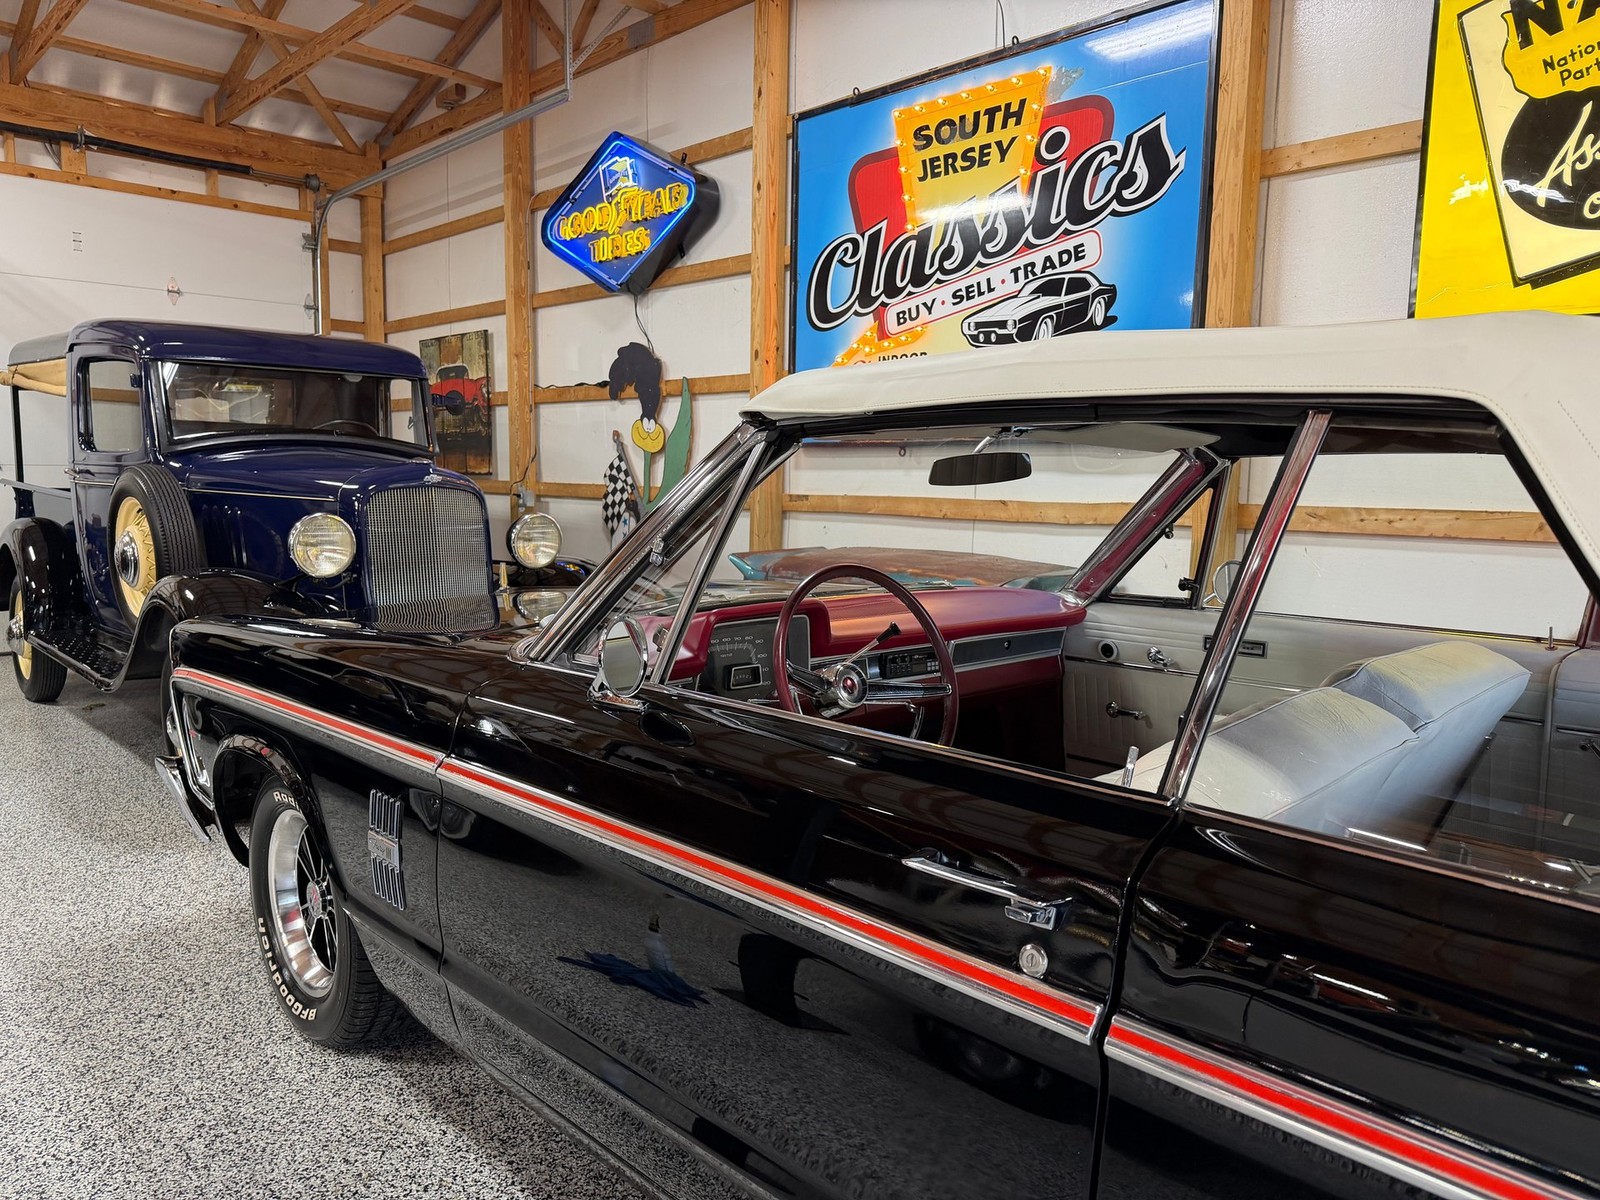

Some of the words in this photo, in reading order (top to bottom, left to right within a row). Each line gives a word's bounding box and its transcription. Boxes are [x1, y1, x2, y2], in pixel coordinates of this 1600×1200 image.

[1542, 41, 1600, 74] Natio
[913, 98, 1027, 152] SOUTH
[917, 135, 1019, 182] JERSEY
[554, 182, 689, 241] GOODYEAR
[807, 113, 1186, 332] Classics
[589, 227, 651, 262] TIRES
[896, 297, 937, 326] BUY
[951, 277, 996, 306] SELL
[1010, 243, 1087, 284] TRADE
